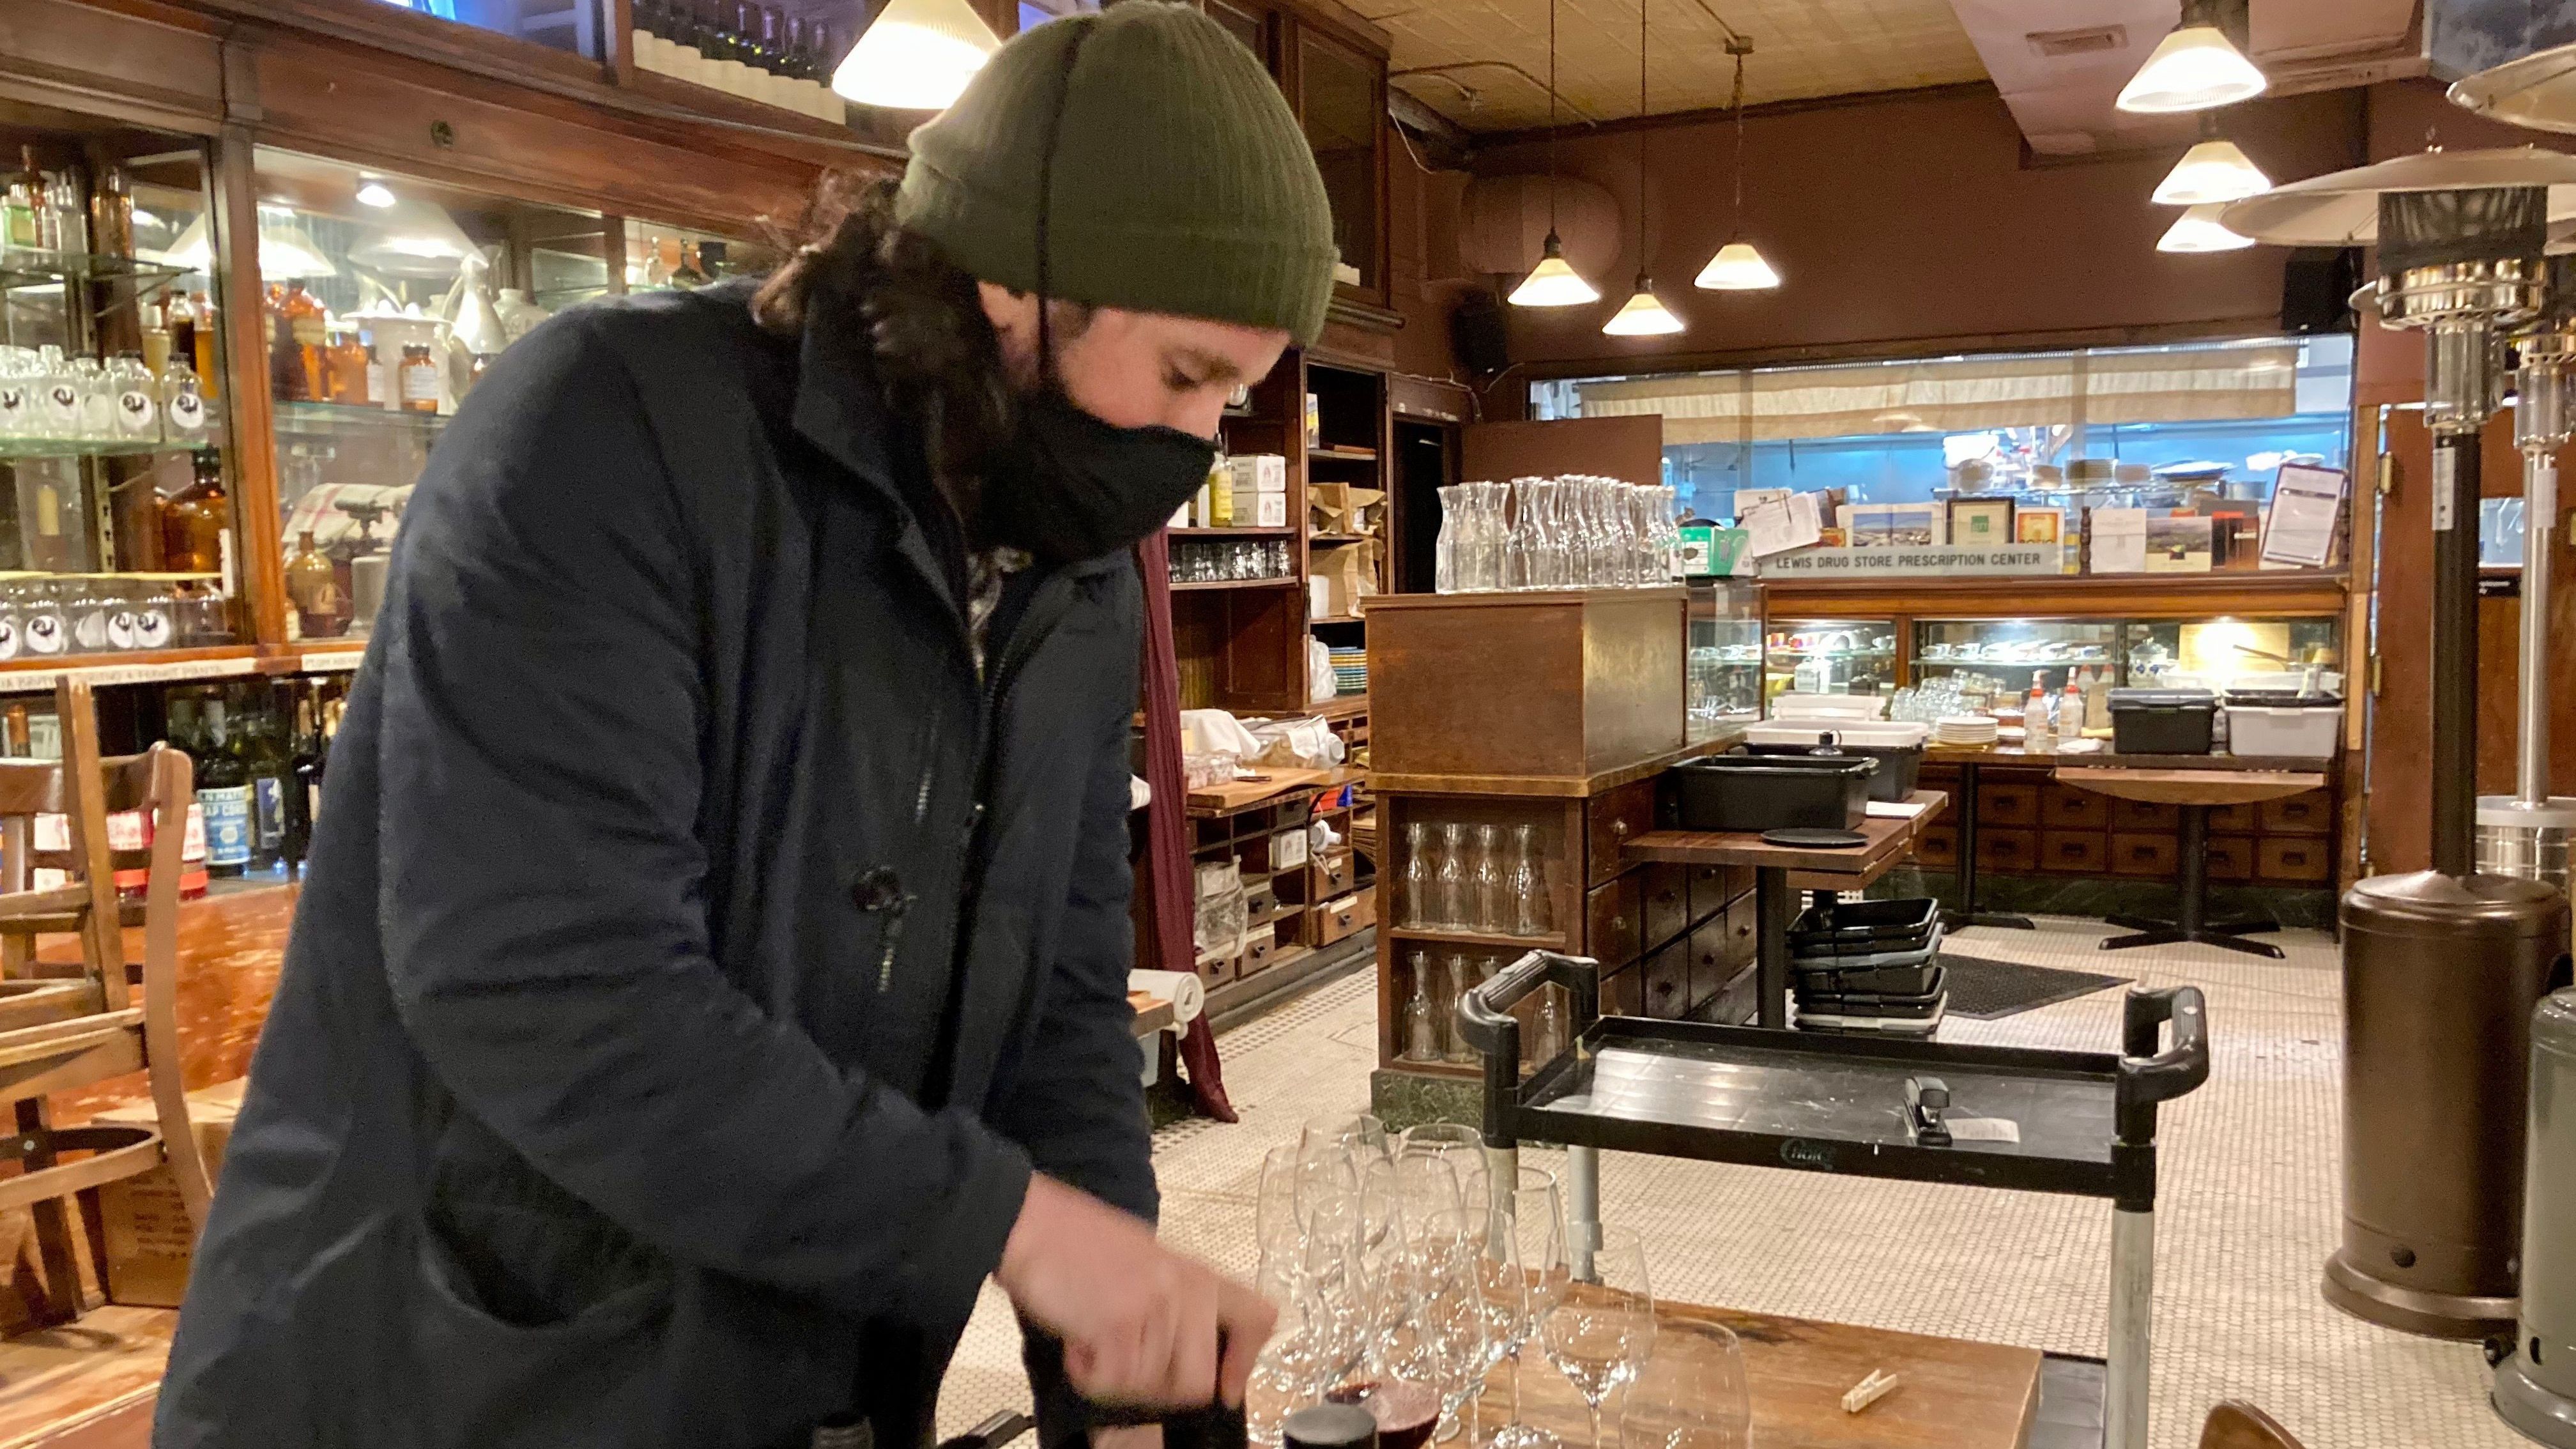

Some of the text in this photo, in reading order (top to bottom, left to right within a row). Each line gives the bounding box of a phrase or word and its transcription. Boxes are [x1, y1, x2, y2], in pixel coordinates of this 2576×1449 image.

[1776, 553, 2041, 569] LEWIS DRUG STORE PRESCRIPTION CENTER
